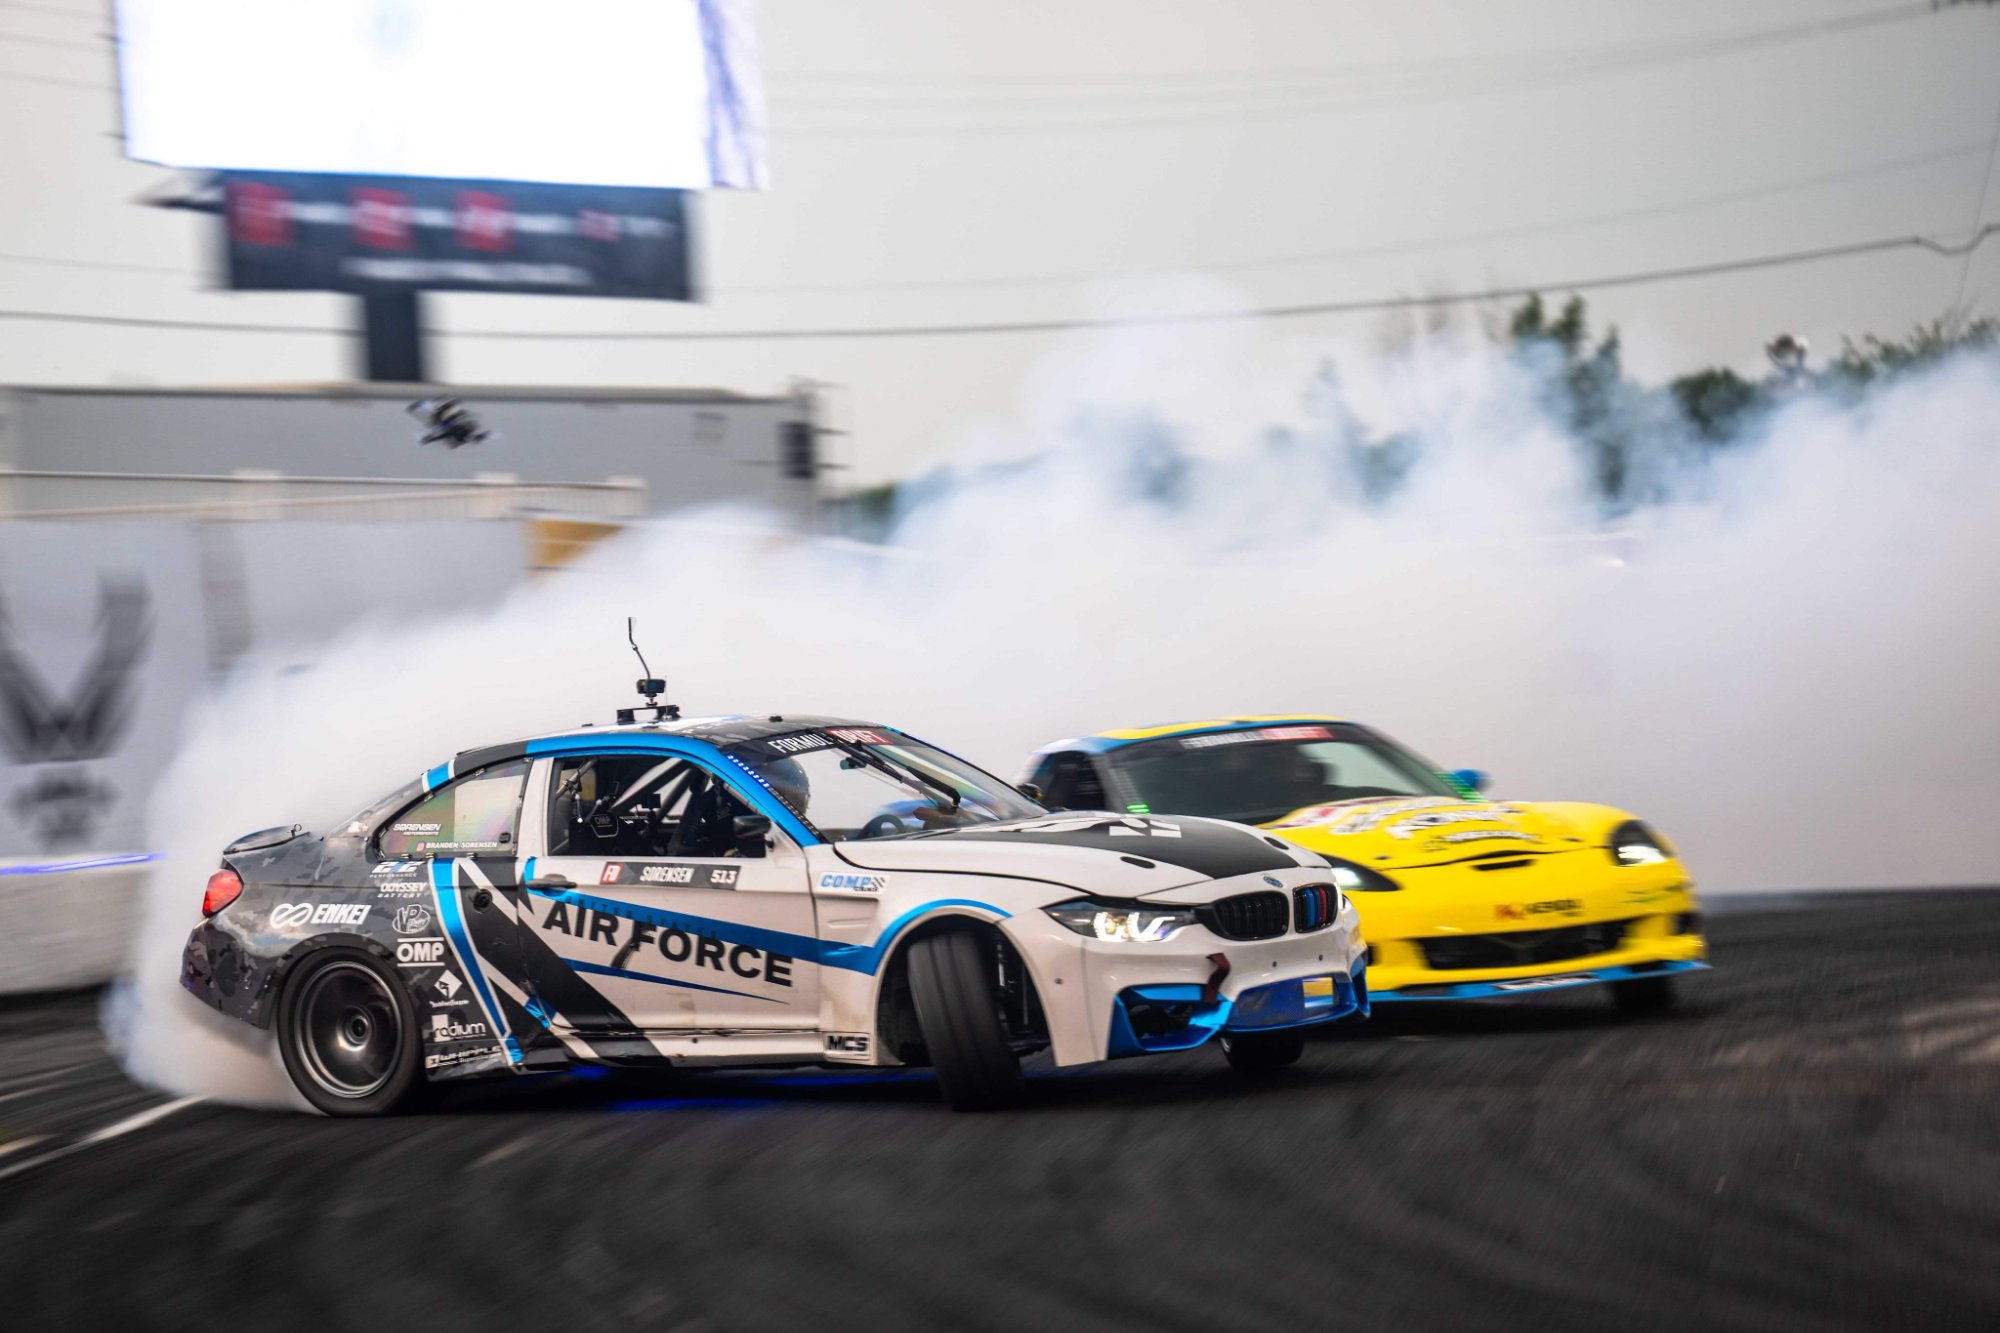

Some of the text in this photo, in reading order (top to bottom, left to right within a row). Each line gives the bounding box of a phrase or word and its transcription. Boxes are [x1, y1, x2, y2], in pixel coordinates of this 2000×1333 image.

[767, 729, 887, 754] FORMUL DRIFT
[602, 864, 738, 884] FD SORENSEN 513
[821, 874, 872, 888] COMP
[380, 882, 428, 892] ODYSSEY
[310, 904, 372, 925] ENKEI
[396, 904, 422, 933] VP
[565, 894, 719, 940] UNITED STATES
[396, 942, 445, 962] OMP
[542, 899, 794, 988] AIR FORCE
[435, 1021, 486, 1038] radium
[827, 1035, 868, 1052] MCS
